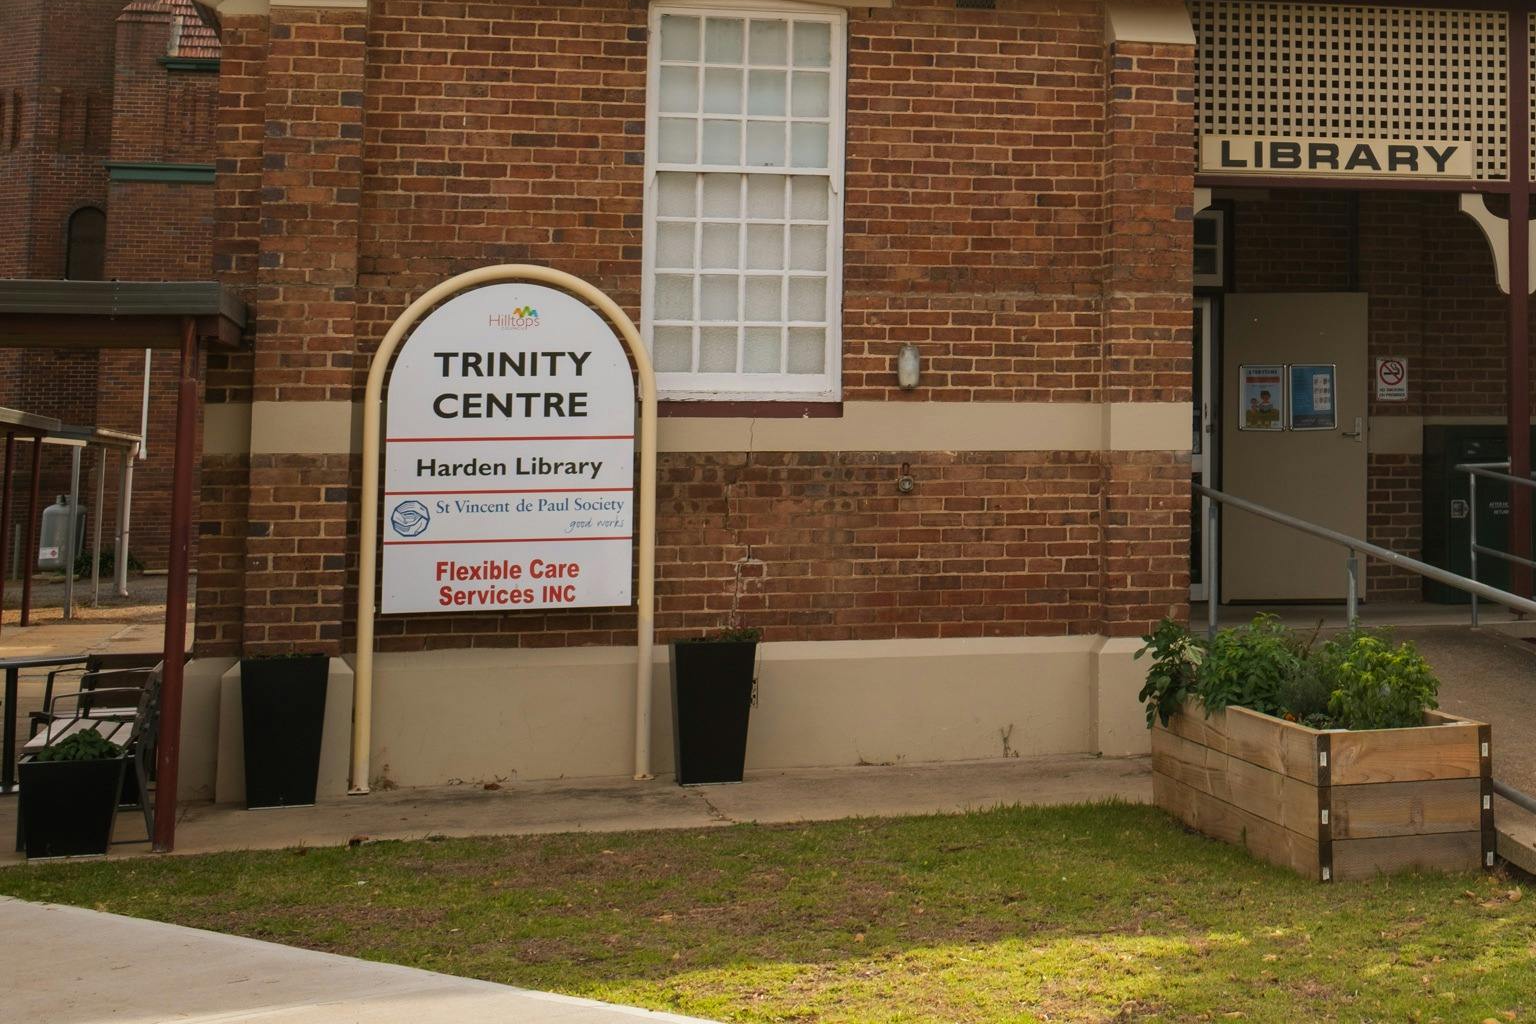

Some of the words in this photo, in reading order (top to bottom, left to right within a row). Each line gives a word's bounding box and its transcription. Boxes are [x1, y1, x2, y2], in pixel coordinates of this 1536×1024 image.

[1220, 140, 1459, 173] LIBRARY
[489, 313, 540, 330] Hilltops
[433, 351, 592, 378] TRINITY
[433, 391, 588, 419] CENTRE
[416, 458, 506, 478] Harden
[516, 457, 603, 480] Library
[436, 499, 450, 514] St
[455, 499, 510, 514] Vincent
[516, 498, 533, 513] de
[539, 497, 569, 513] Paul
[574, 497, 625, 516] Society
[568, 518, 592, 534] good
[596, 517, 625, 529] works
[436, 560, 522, 582] Flexible
[529, 559, 580, 580] Care
[439, 585, 535, 607] Services
[542, 584, 577, 604] INC
